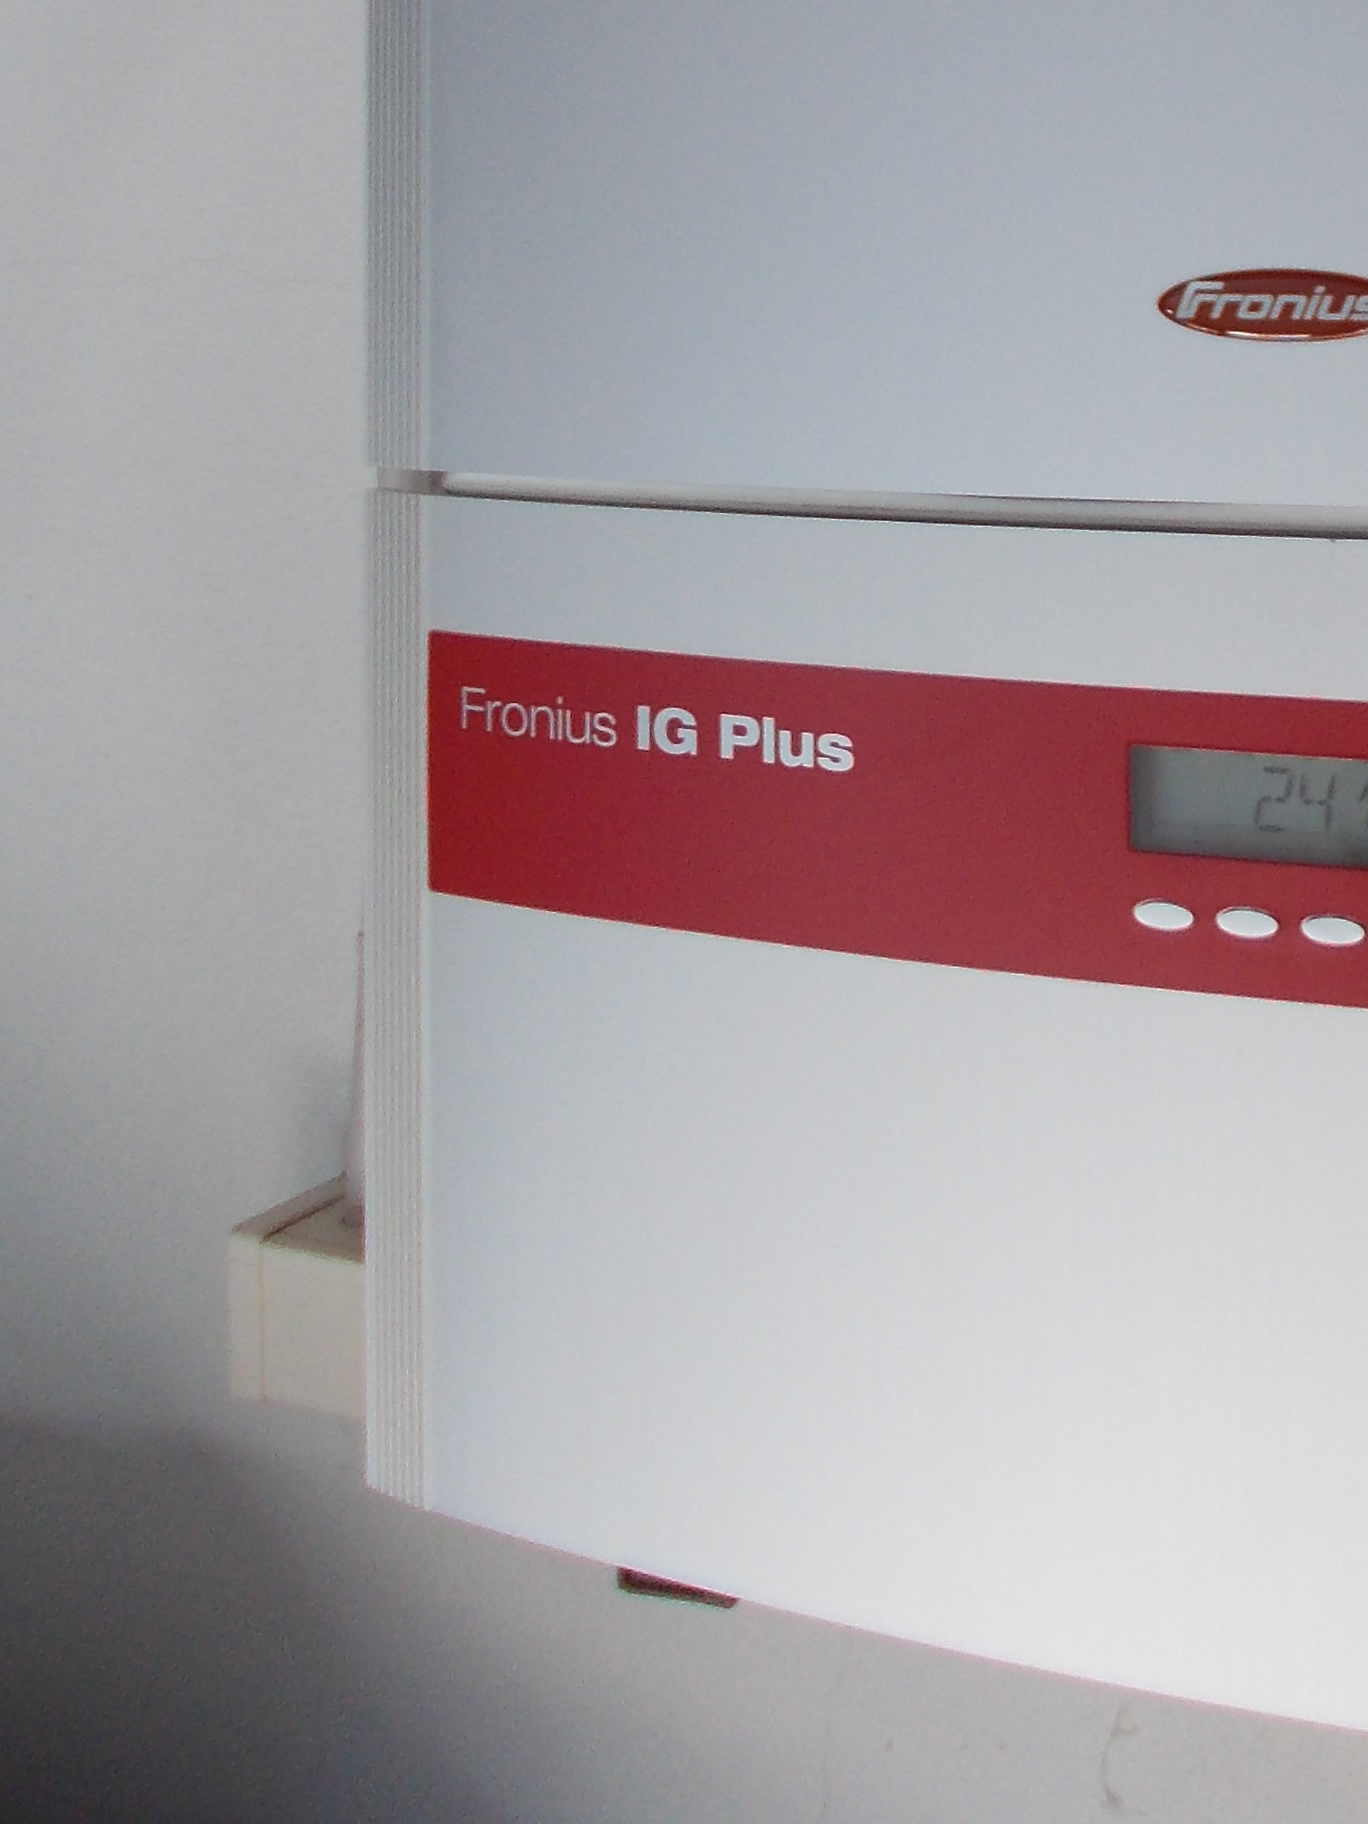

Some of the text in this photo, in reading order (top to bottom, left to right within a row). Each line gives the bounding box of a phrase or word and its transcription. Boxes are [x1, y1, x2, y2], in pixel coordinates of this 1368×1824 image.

[460, 686, 854, 772] Fronius IG Plus
